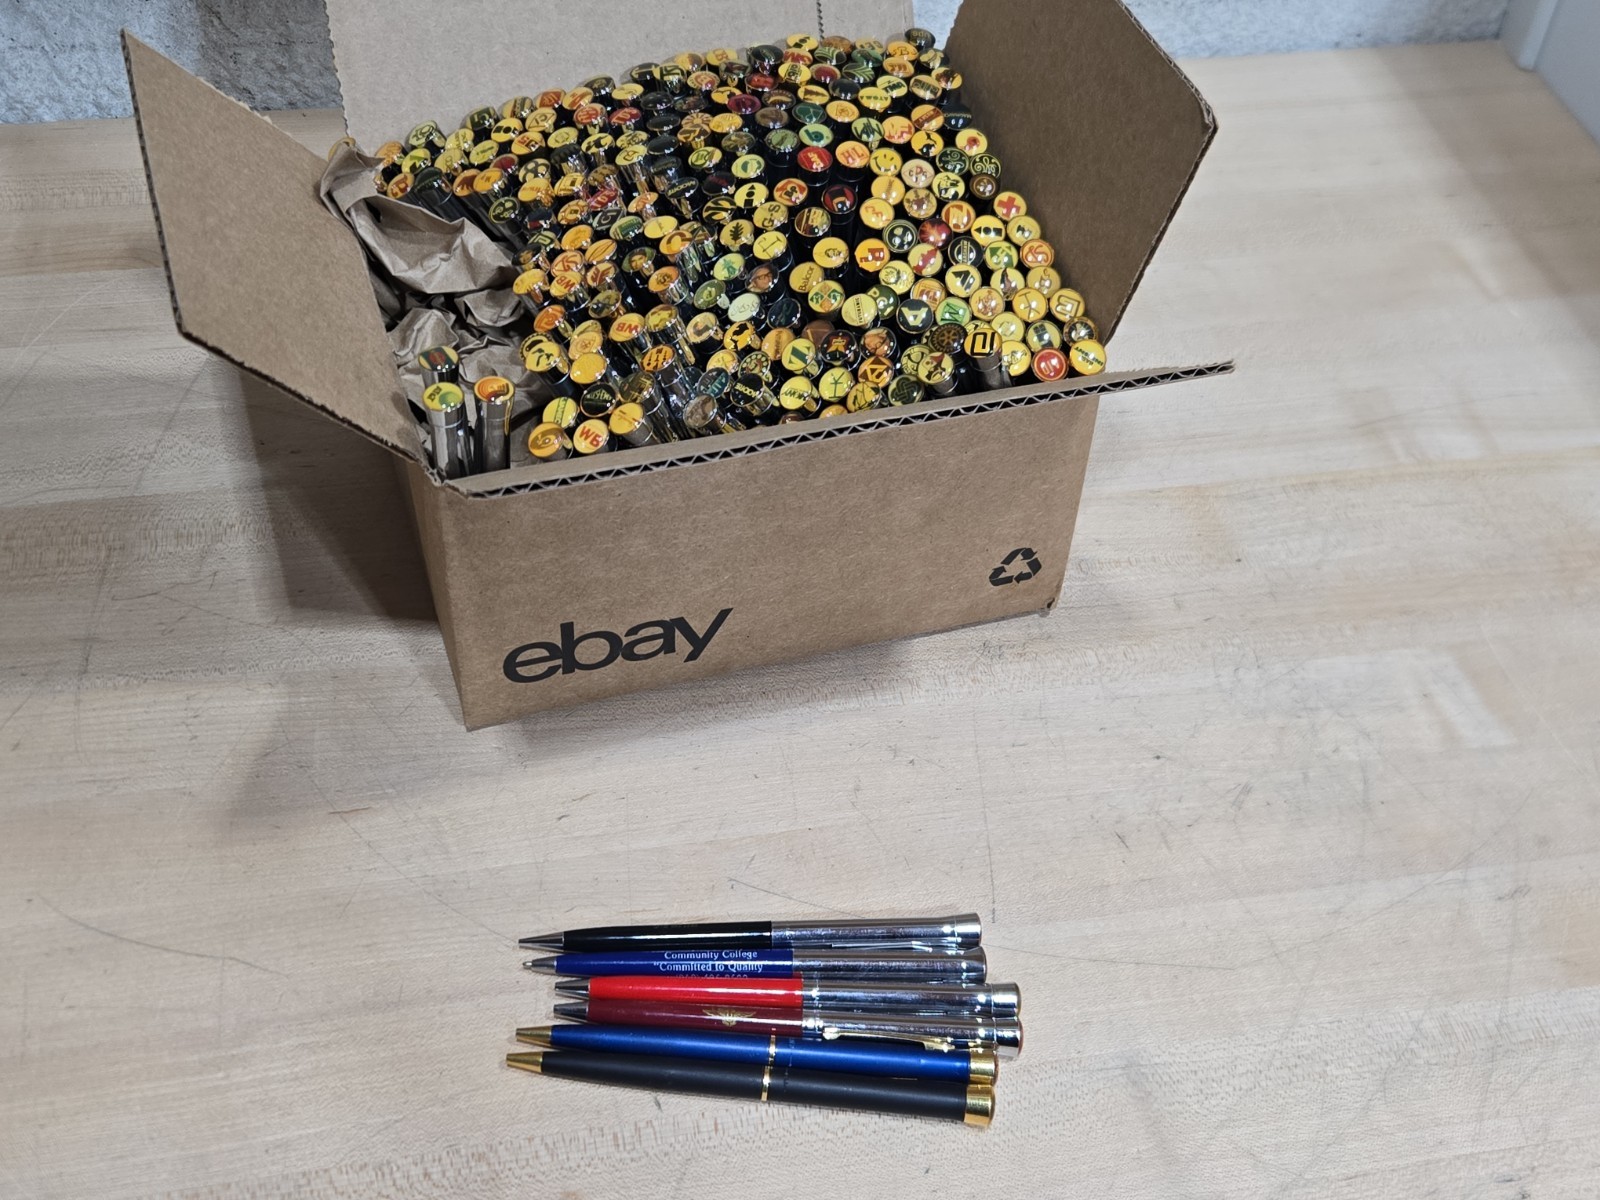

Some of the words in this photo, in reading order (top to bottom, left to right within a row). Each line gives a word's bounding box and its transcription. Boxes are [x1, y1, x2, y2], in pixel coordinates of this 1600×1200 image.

[615, 322, 640, 335] WB
[579, 425, 604, 448] WB
[503, 607, 734, 684] ebay
[664, 950, 719, 960] Community
[722, 950, 758, 960] College
[714, 961, 725, 972] to
